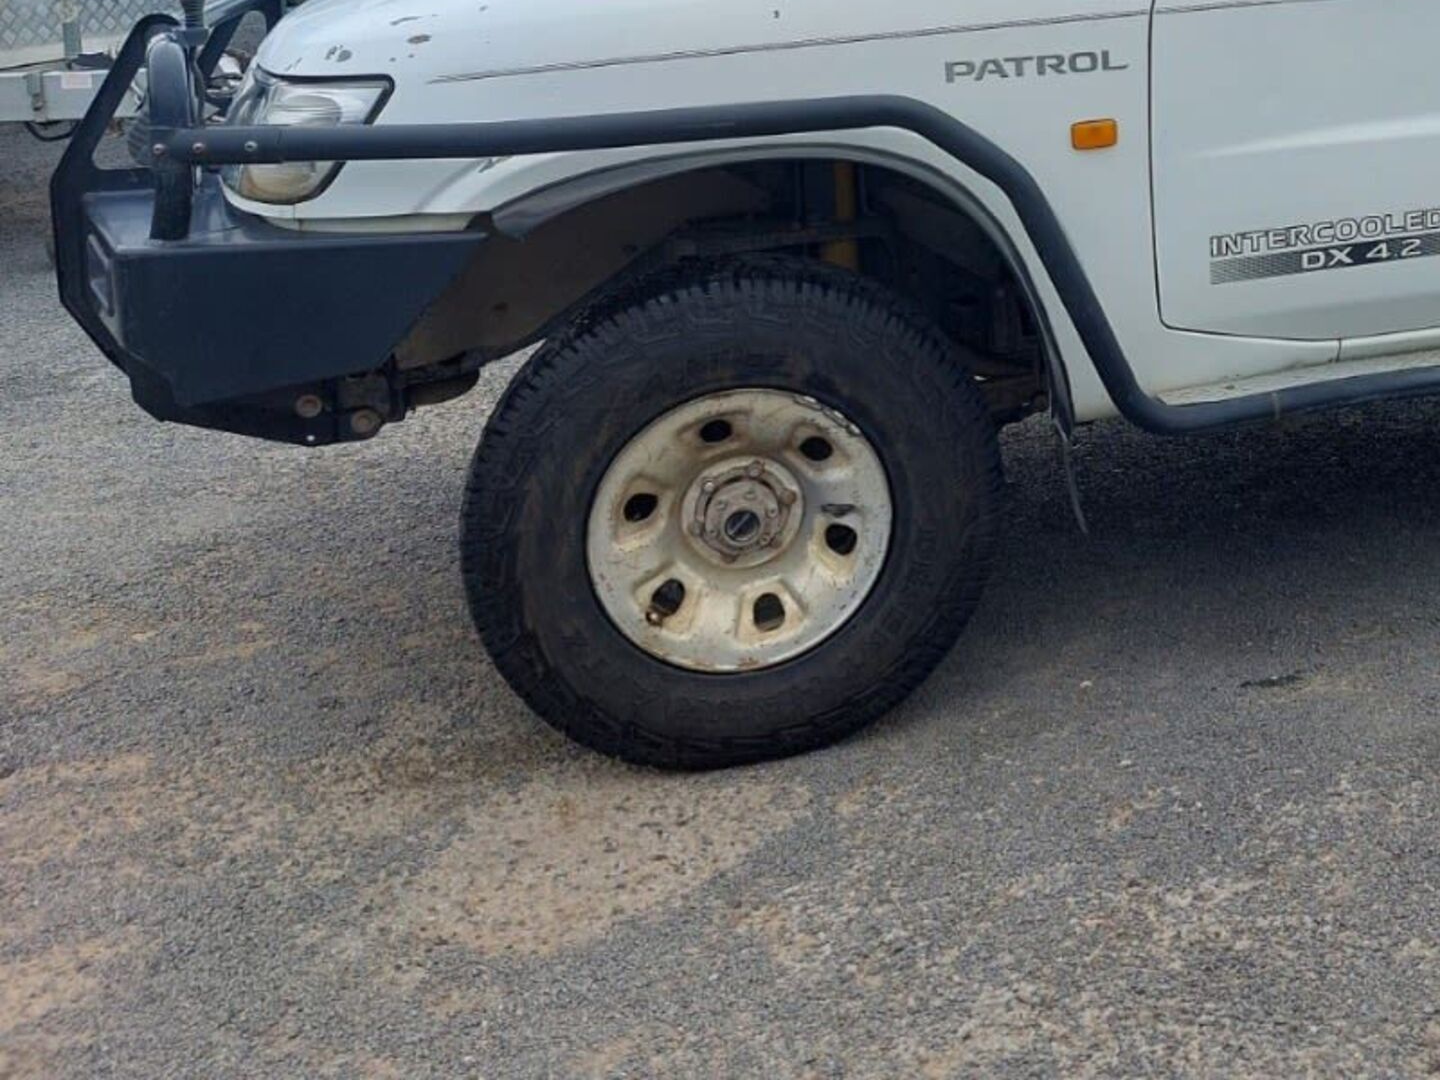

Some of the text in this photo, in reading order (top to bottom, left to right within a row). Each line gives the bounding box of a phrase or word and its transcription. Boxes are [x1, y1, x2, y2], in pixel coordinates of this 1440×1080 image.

[944, 50, 1130, 83] PATROL
[1301, 238, 1422, 270] DX 4.2
